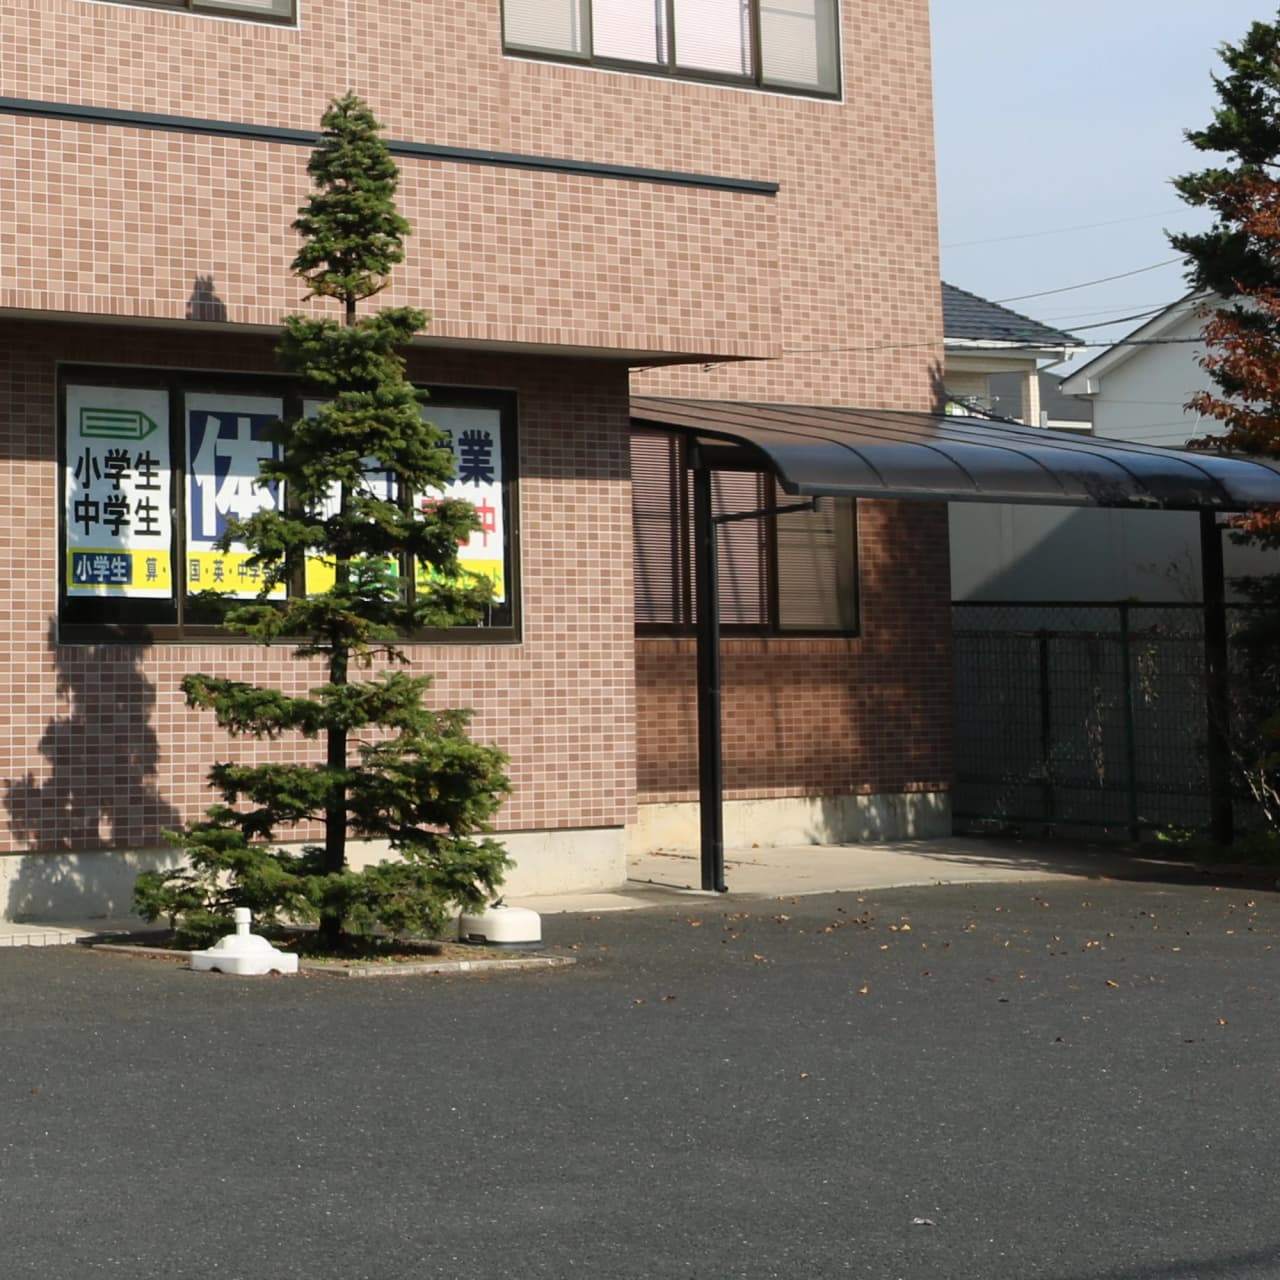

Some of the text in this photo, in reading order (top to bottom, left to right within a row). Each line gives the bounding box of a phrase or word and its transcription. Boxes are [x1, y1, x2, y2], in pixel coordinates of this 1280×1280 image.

[74, 446, 162, 492] 小学生
[73, 493, 162, 537] 中学生
[76, 554, 129, 583] 小学生
